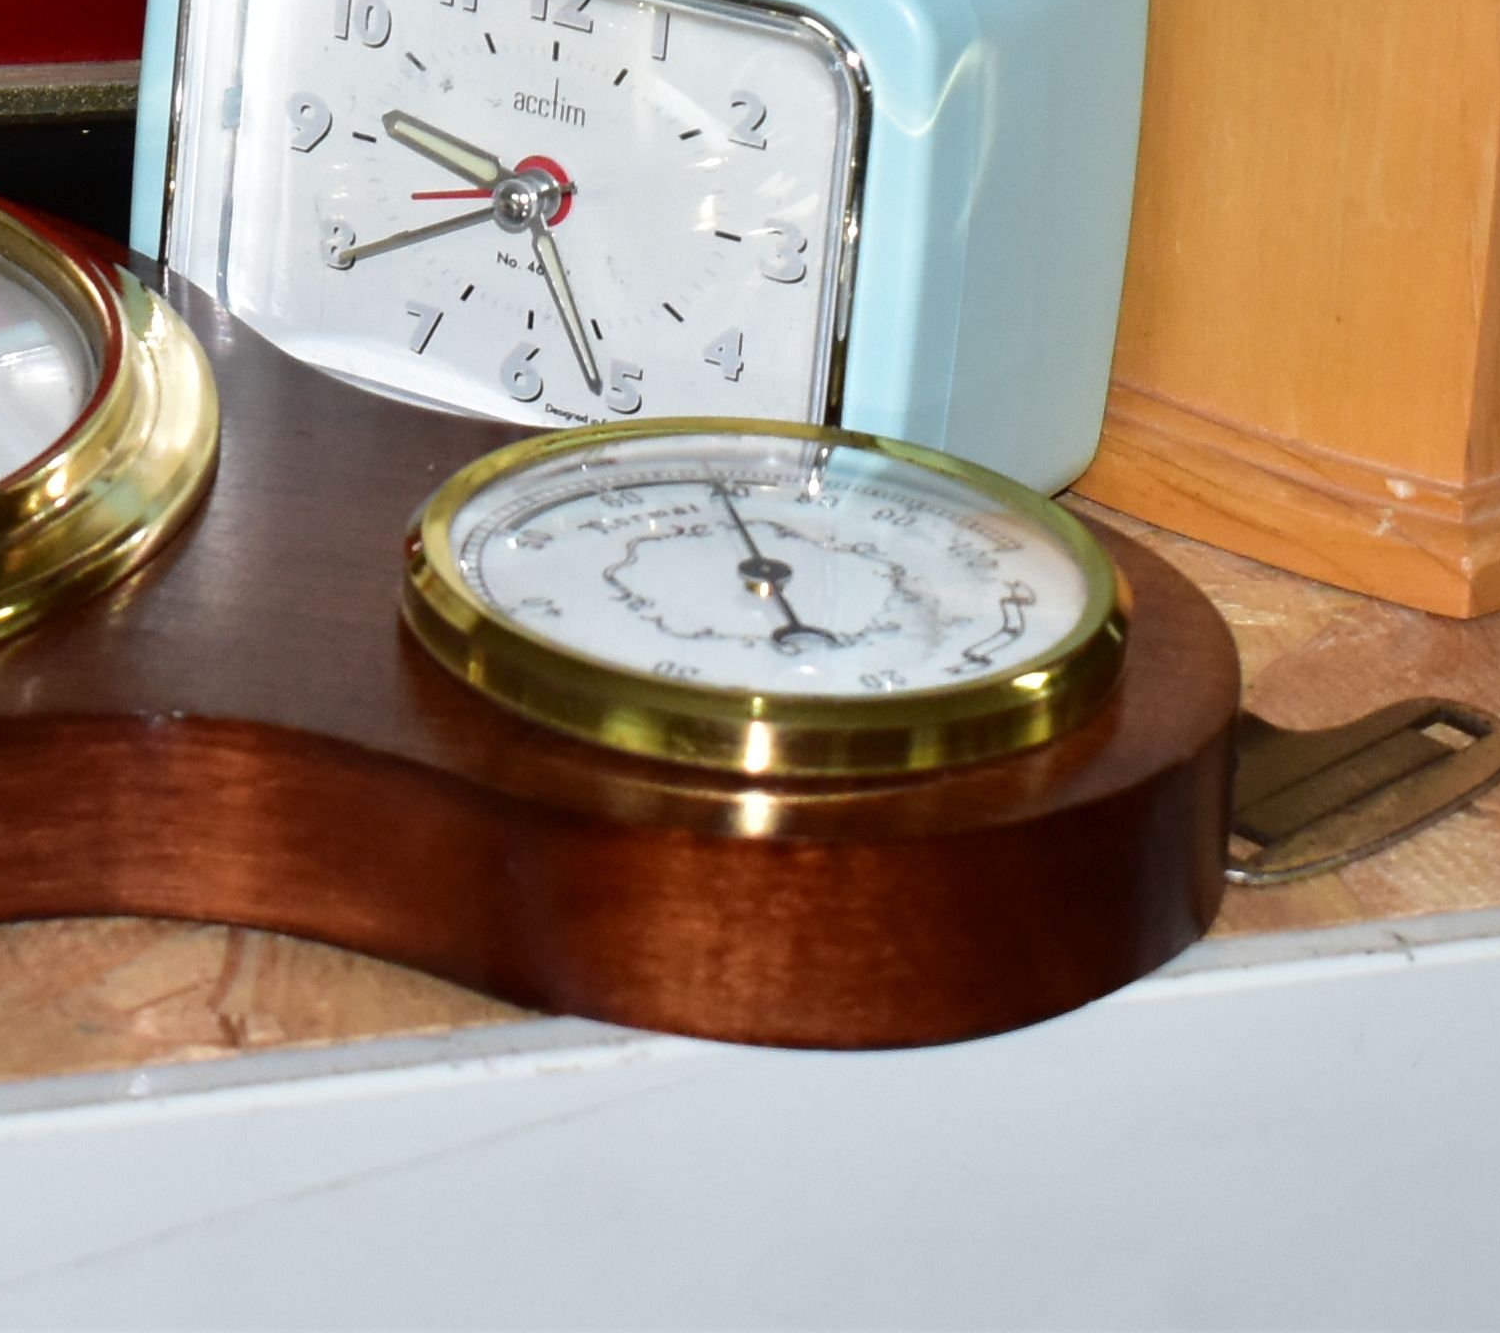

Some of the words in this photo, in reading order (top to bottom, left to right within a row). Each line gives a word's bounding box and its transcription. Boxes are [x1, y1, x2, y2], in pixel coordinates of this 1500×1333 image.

[651, 8, 671, 62] 1
[287, 91, 333, 153] 9
[512, 77, 586, 128] acctim
[729, 89, 767, 150] 2
[320, 218, 356, 271] 8
[497, 251, 522, 270] No.
[759, 218, 807, 284] 3
[405, 299, 444, 355] 7
[704, 326, 744, 382] 4
[500, 339, 544, 403] 6
[605, 357, 643, 415] 5
